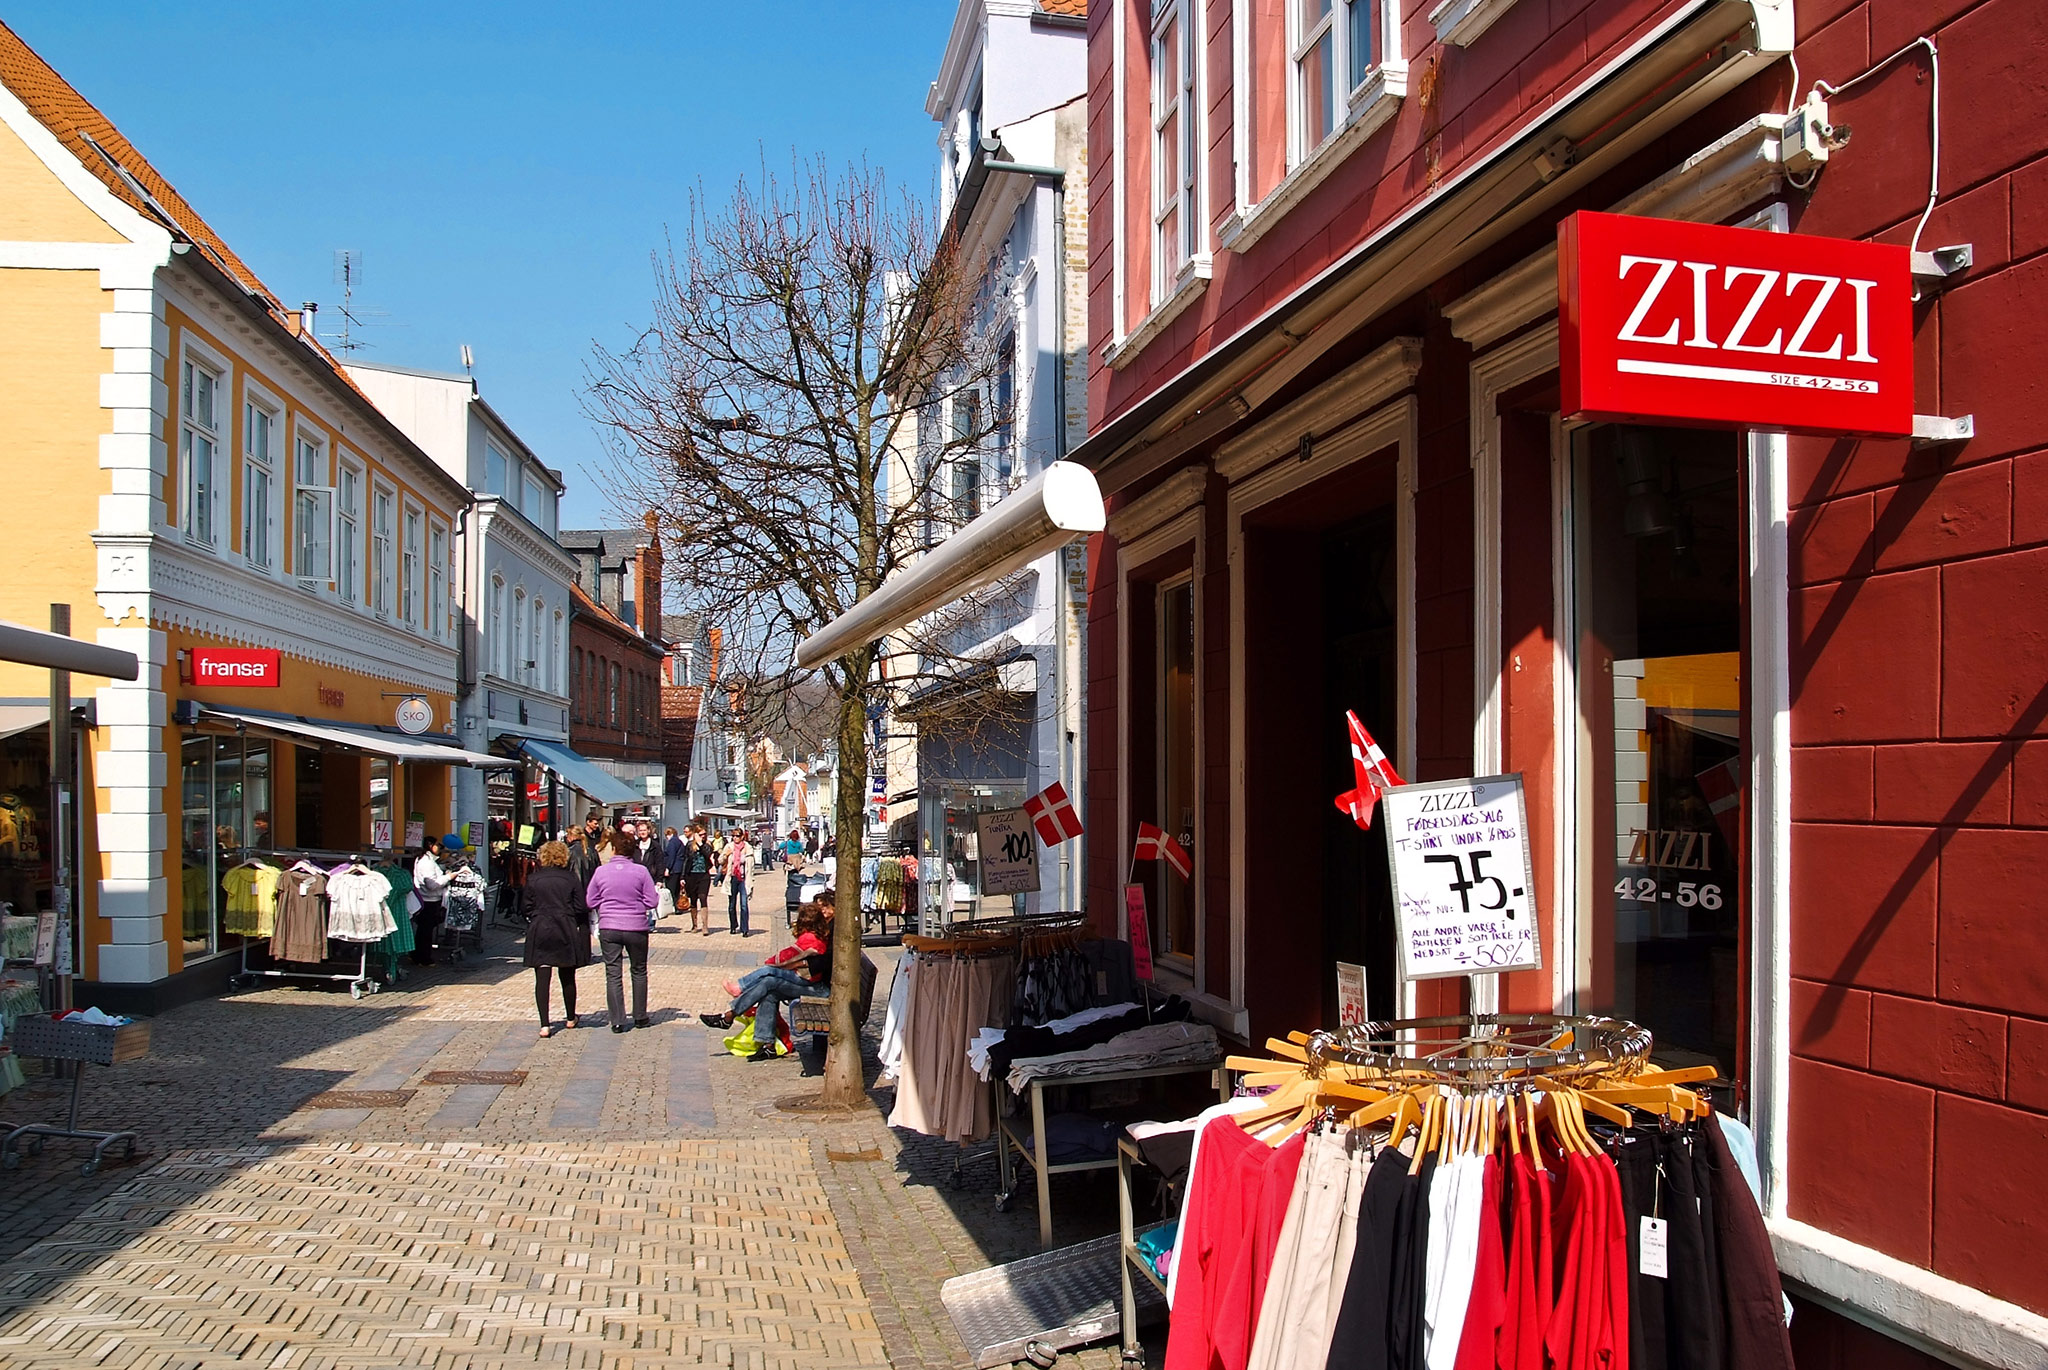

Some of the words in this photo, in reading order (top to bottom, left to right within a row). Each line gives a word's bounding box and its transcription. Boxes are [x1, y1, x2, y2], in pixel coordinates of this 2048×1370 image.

[1617, 255, 1879, 363] ZIZZI
[1770, 374, 1800, 386] SIZE
[1806, 377, 1870, 392] 42-56
[200, 658, 267, 677] fransa
[402, 711, 425, 722] SKO
[1628, 827, 1712, 871] ZIZZI
[1614, 877, 1723, 910] 42-56
[1412, 929, 1431, 938] ALLE
[1434, 927, 1464, 937] ANDRE
[1467, 922, 1496, 934] VARER
[1468, 932, 1488, 944] SOM
[1518, 929, 1531, 941] ER
[1414, 947, 1452, 960] NEDSAT
